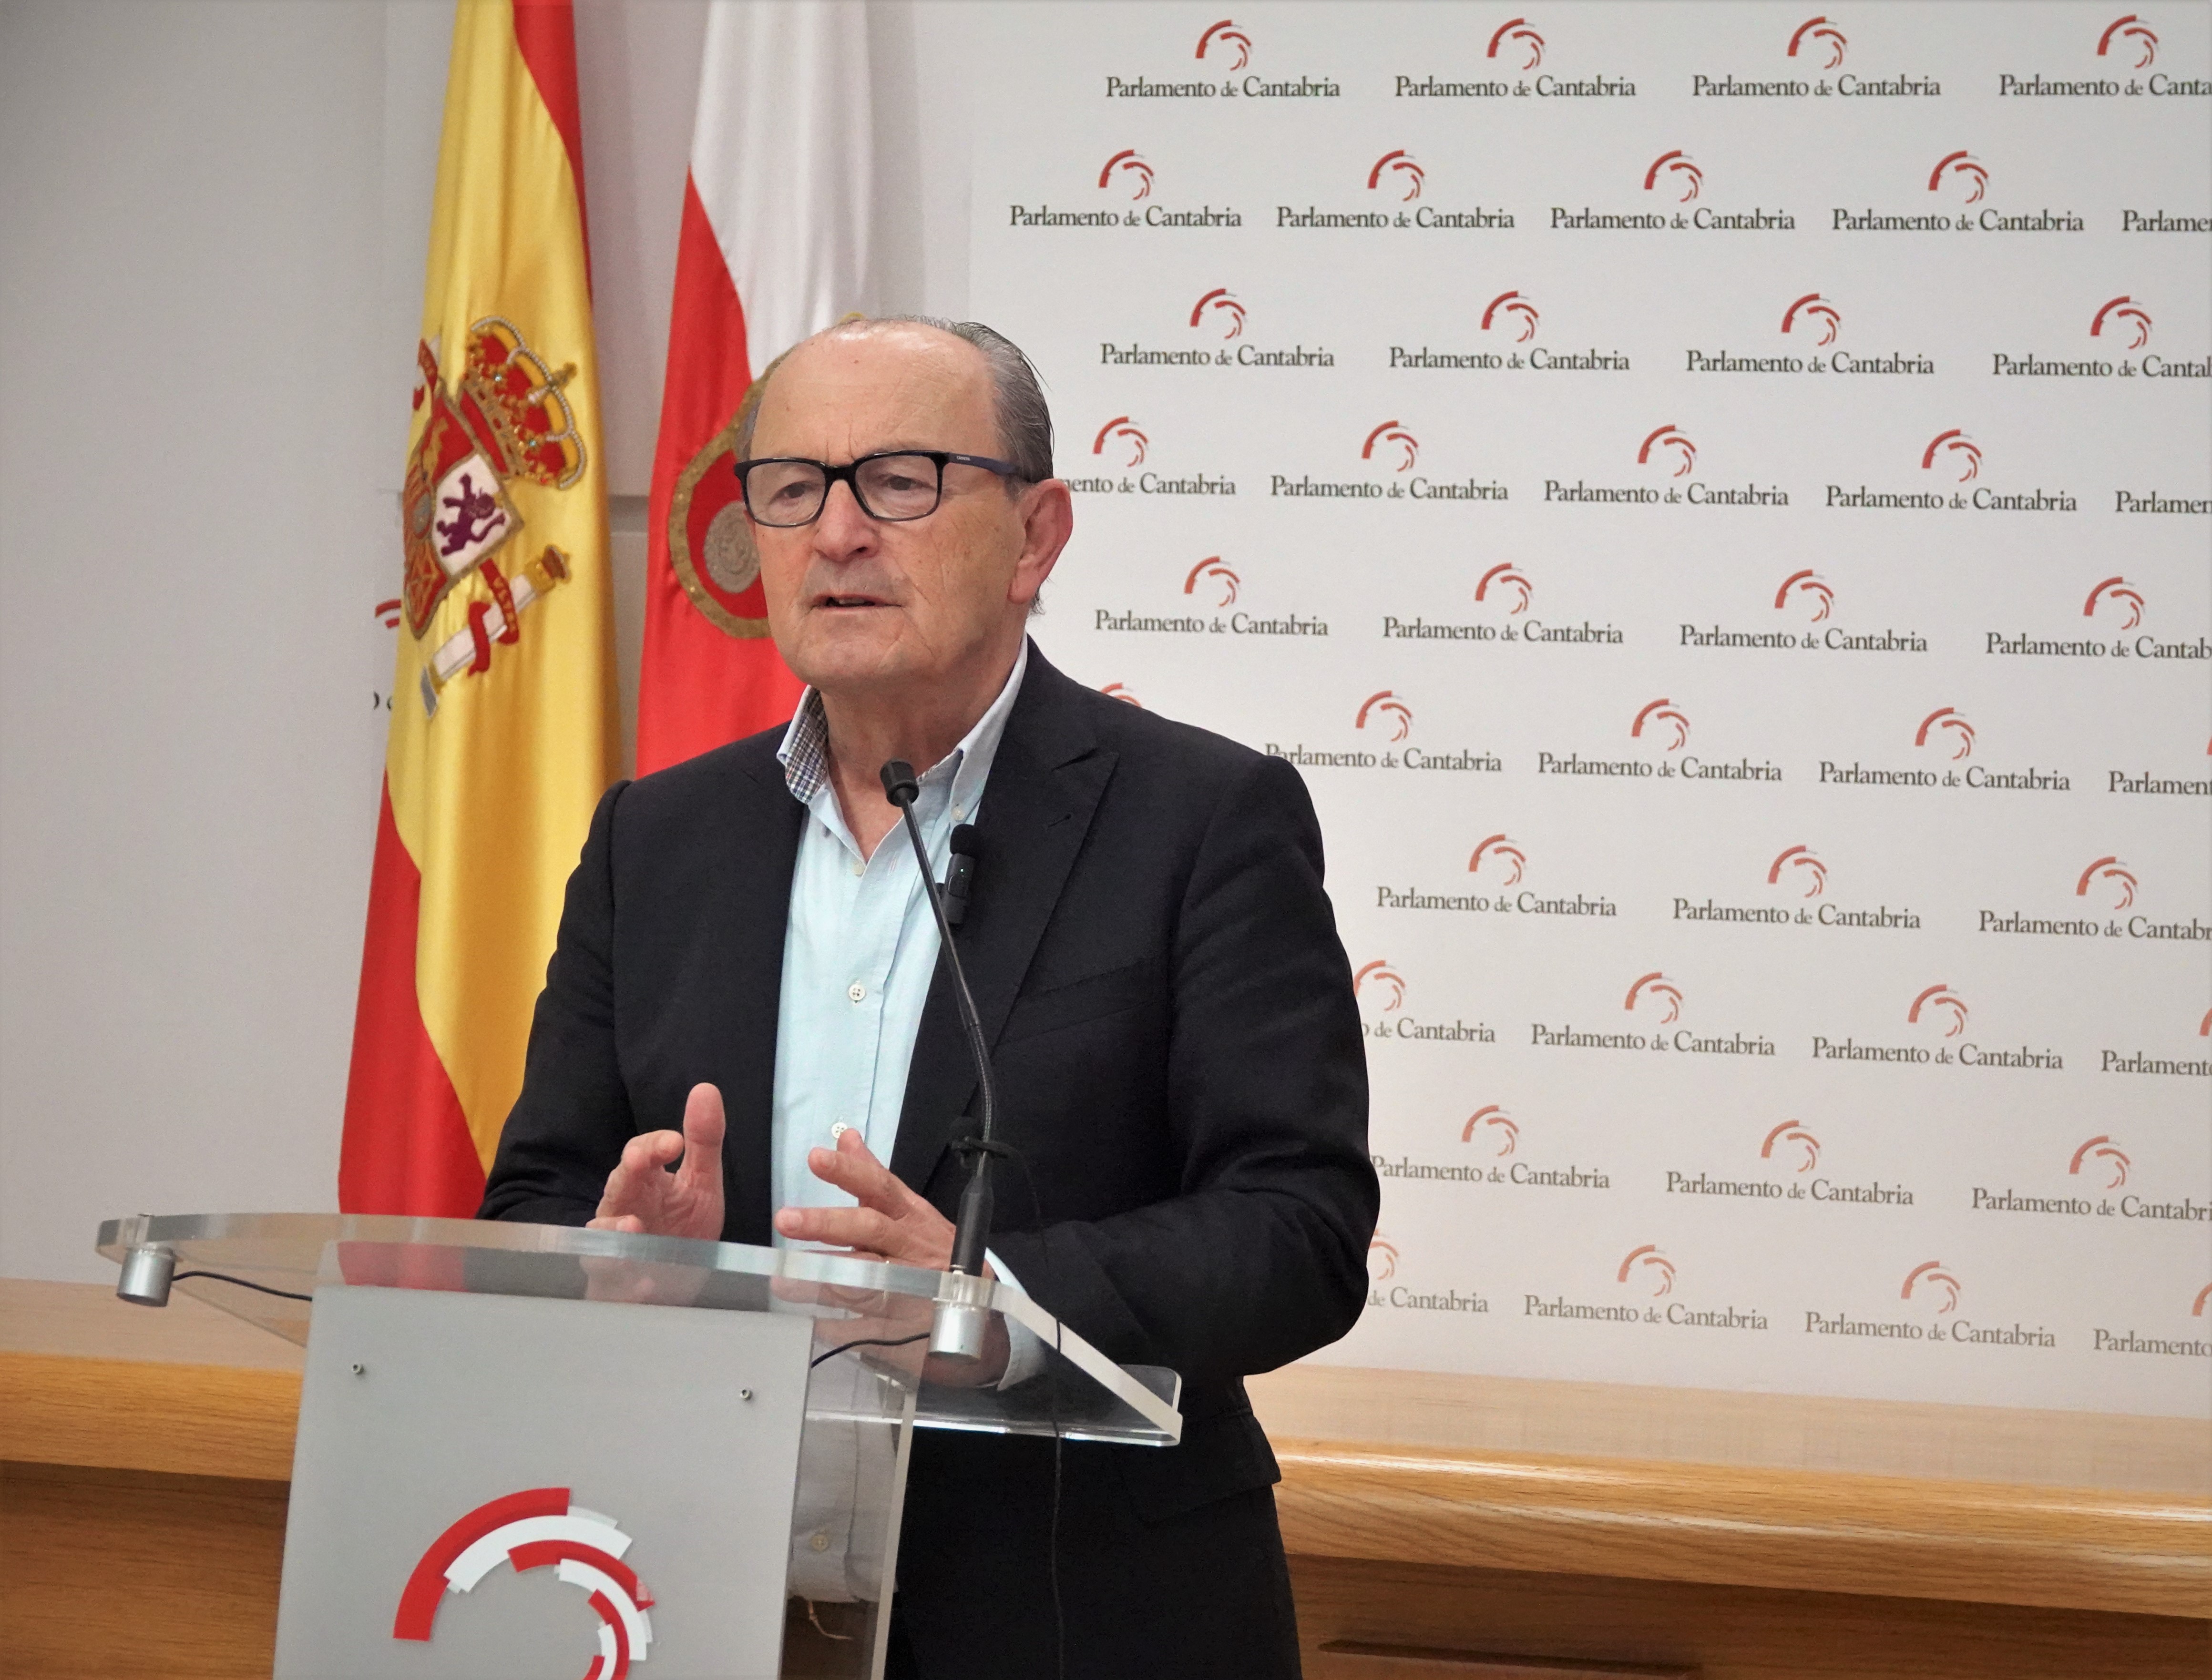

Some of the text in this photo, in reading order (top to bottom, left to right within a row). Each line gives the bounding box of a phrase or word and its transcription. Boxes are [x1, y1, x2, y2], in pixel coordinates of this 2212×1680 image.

[1106, 75, 1341, 98] Parlamento de Cantabria
[1394, 74, 1637, 98] Parlamento de Cantabria
[1692, 73, 1942, 97] Parlamento de Cantabria
[1998, 72, 2120, 97] Parlamento
[2124, 78, 2144, 97] de
[1009, 204, 1242, 228] Parlamento de Cantabria
[1276, 205, 1516, 229] Parlamento de Cantabria
[1549, 206, 1796, 231] Parlamento de Cantabria
[1832, 208, 2085, 232] Parlamento de Cantabria
[2121, 209, 2212, 233] Parlame
[1100, 342, 1335, 367] Parlamento de Cantabria
[1389, 346, 1630, 371] Parlamento de Cantabria
[1685, 349, 1935, 375] Parlamento de Cantabria
[1992, 353, 2114, 377] Parlamento
[2117, 359, 2138, 378] de
[1117, 476, 1136, 494] de
[1138, 471, 1237, 496] Cantabria
[1270, 474, 1509, 501] Parlamento de Cantabria
[1543, 479, 1789, 506] Parlamento de Cantabria
[1825, 484, 2078, 512] Parlamento de Cantabria
[1095, 609, 1329, 637] Parlamento de Cantabria
[1382, 616, 1624, 644] Parlamento de Cantabria
[1679, 623, 1928, 652] Parlamento de Cantabria
[1986, 631, 2107, 657] Parlamento
[2110, 639, 2130, 658] de
[1380, 751, 1399, 769] de
[1403, 747, 1503, 772] Cantabria
[1538, 752, 1783, 782] Parlamento de Cantabria
[1819, 761, 2071, 791] Parlamento de Cantabria
[1377, 886, 1617, 917] Parlamento de Cantabria
[1673, 897, 1921, 929] Parlamento de Cantabria
[1978, 909, 2099, 937] Parlamento
[2103, 919, 2123, 938] de
[1373, 1021, 1392, 1039] de
[1396, 1017, 1496, 1043] Cantabria
[1531, 1023, 1775, 1056] Parlamento de Cantabria
[1812, 1036, 2064, 1070] Parlamento de Cantabria
[1486, 1166, 1505, 1184] de
[1510, 1162, 1610, 1189] Cantabria
[1666, 1171, 1914, 1206] Parlamento de Cantabria
[1972, 1187, 2092, 1216] Parlamento
[2096, 1199, 2116, 1217] de
[1367, 1286, 1488, 1313] de Cantabria
[1523, 1294, 1769, 1330] Parlamento de Cantabria
[1804, 1311, 2057, 1347] Parlamento de Cantabria
